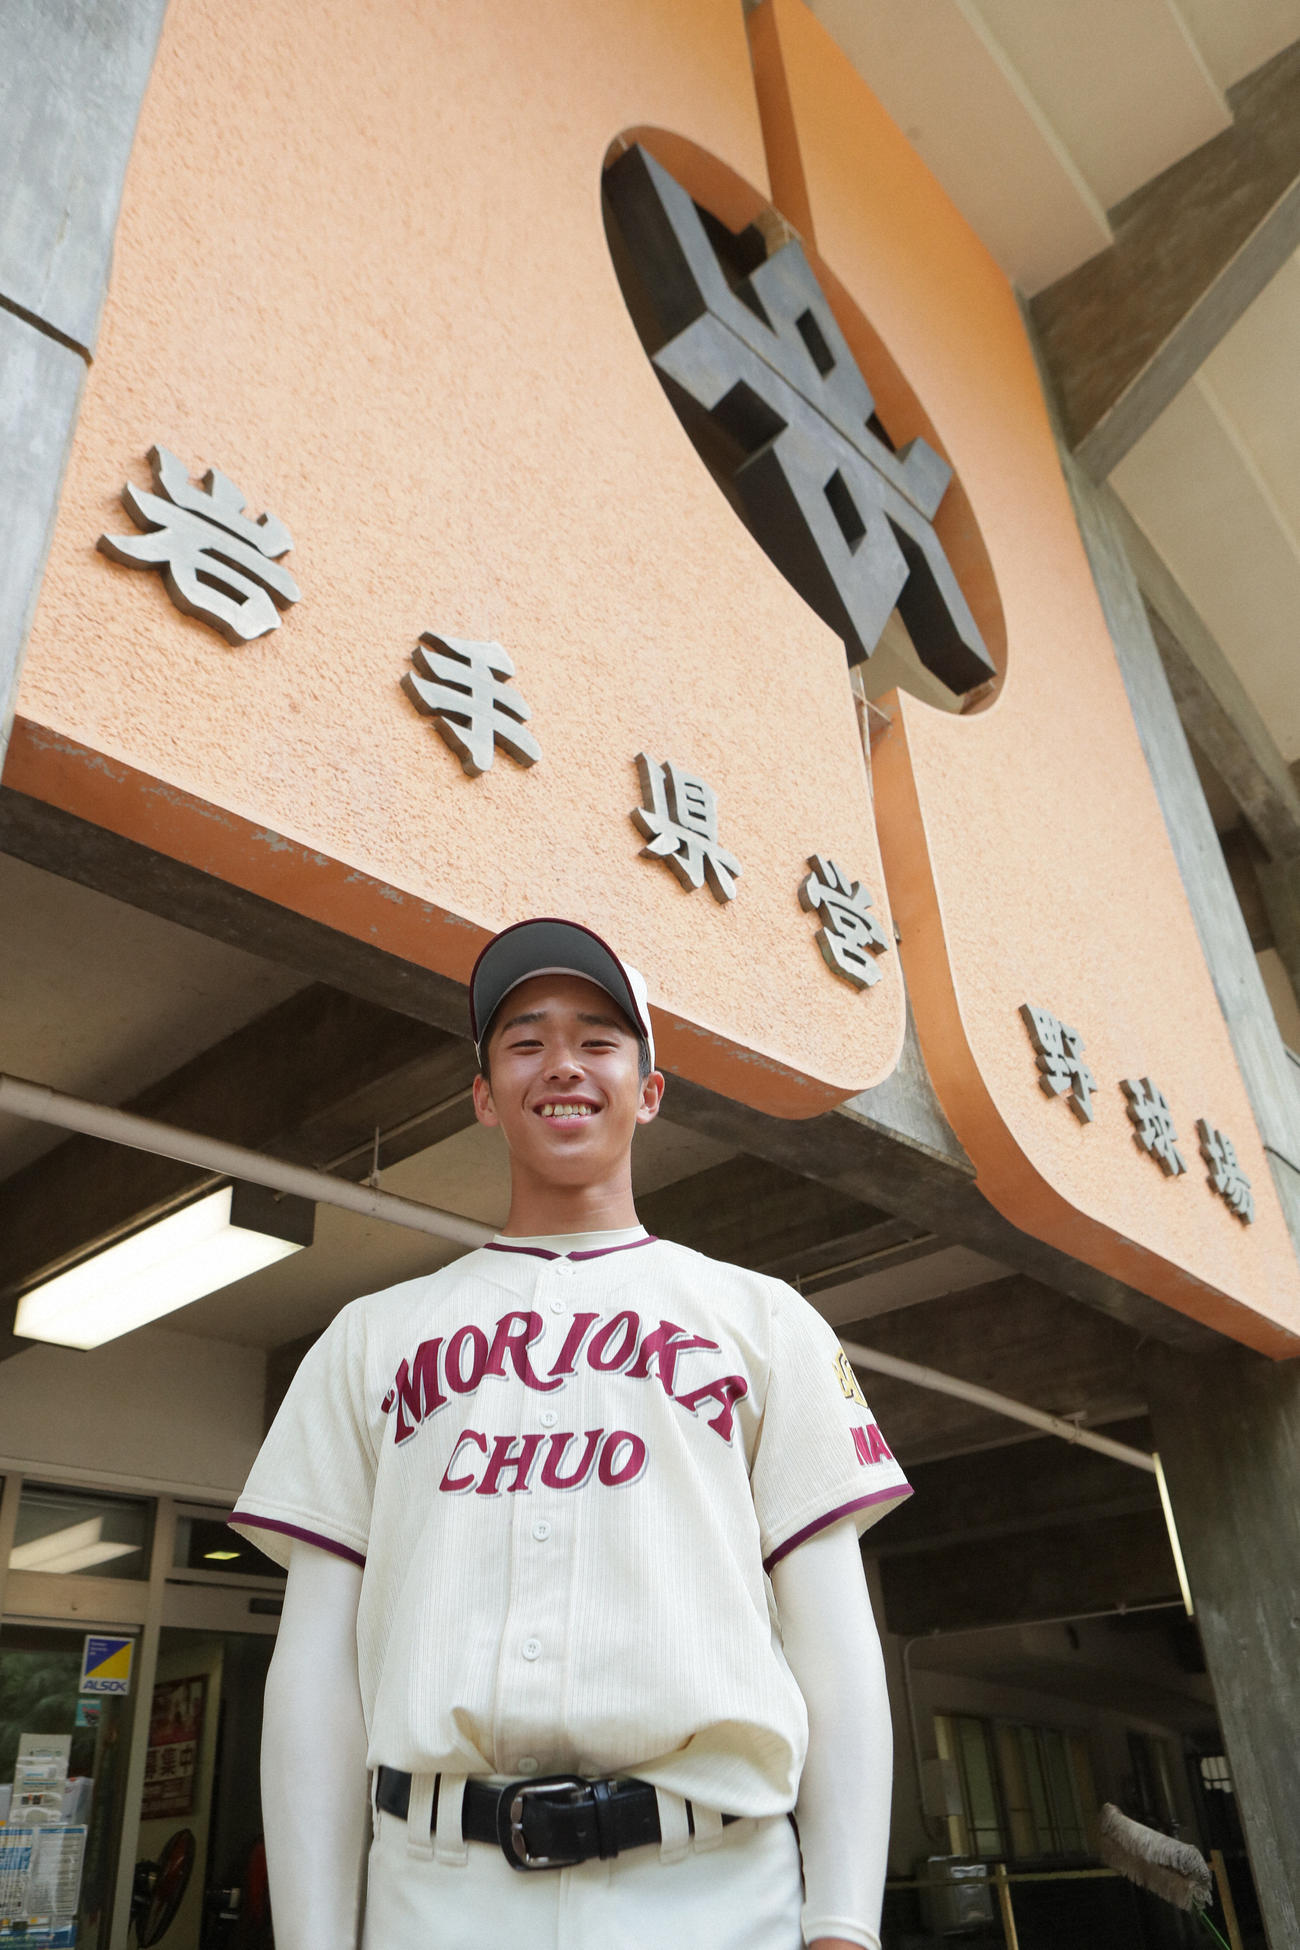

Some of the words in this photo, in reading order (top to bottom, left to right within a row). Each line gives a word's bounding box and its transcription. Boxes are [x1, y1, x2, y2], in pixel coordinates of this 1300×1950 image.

[381, 1310, 749, 1446] MORIOKA
[439, 1428, 649, 1497] CHUO
[83, 1680, 127, 1692] ALSOK
